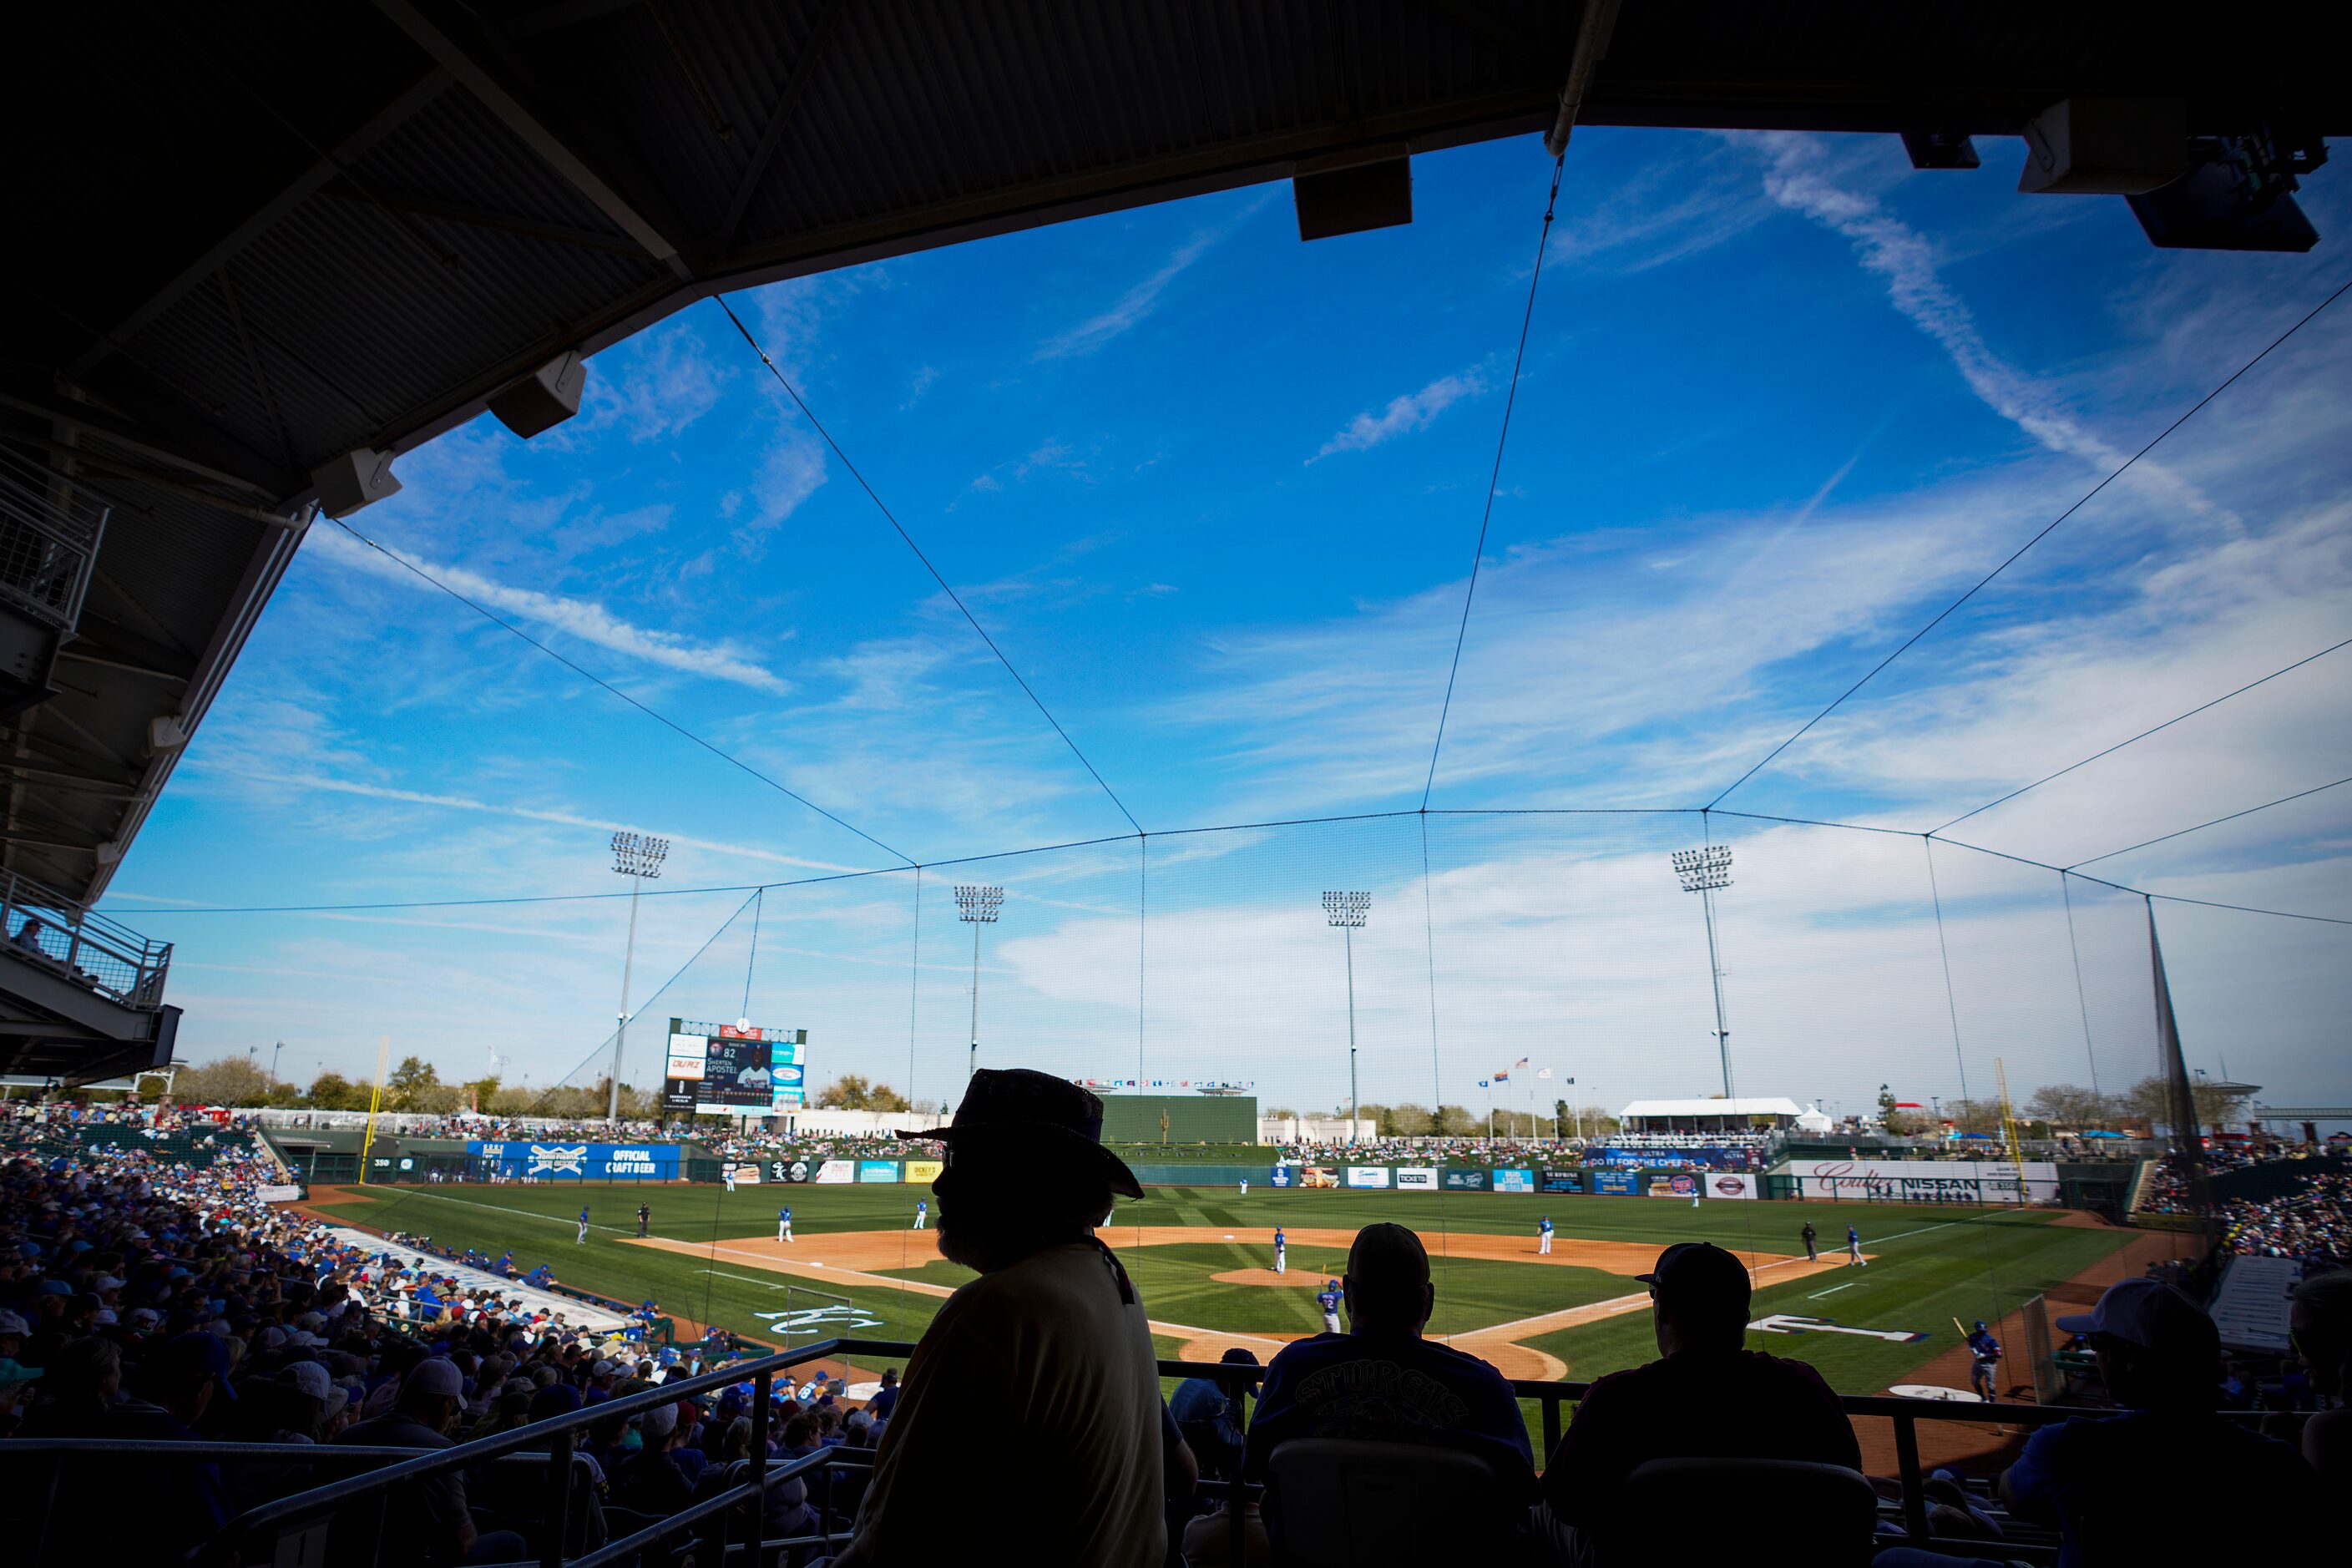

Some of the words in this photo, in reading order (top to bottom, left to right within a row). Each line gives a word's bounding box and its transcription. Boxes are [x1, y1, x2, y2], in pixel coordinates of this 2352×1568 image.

[723, 1048, 736, 1058] 82
[706, 1065, 738, 1074] APOSTEL
[613, 1150, 651, 1161] OFFICIAL
[633, 1162, 655, 1174] BEER
[1903, 1178, 1979, 1190] NISSAN
[1295, 1358, 1470, 1427] STURGIS
